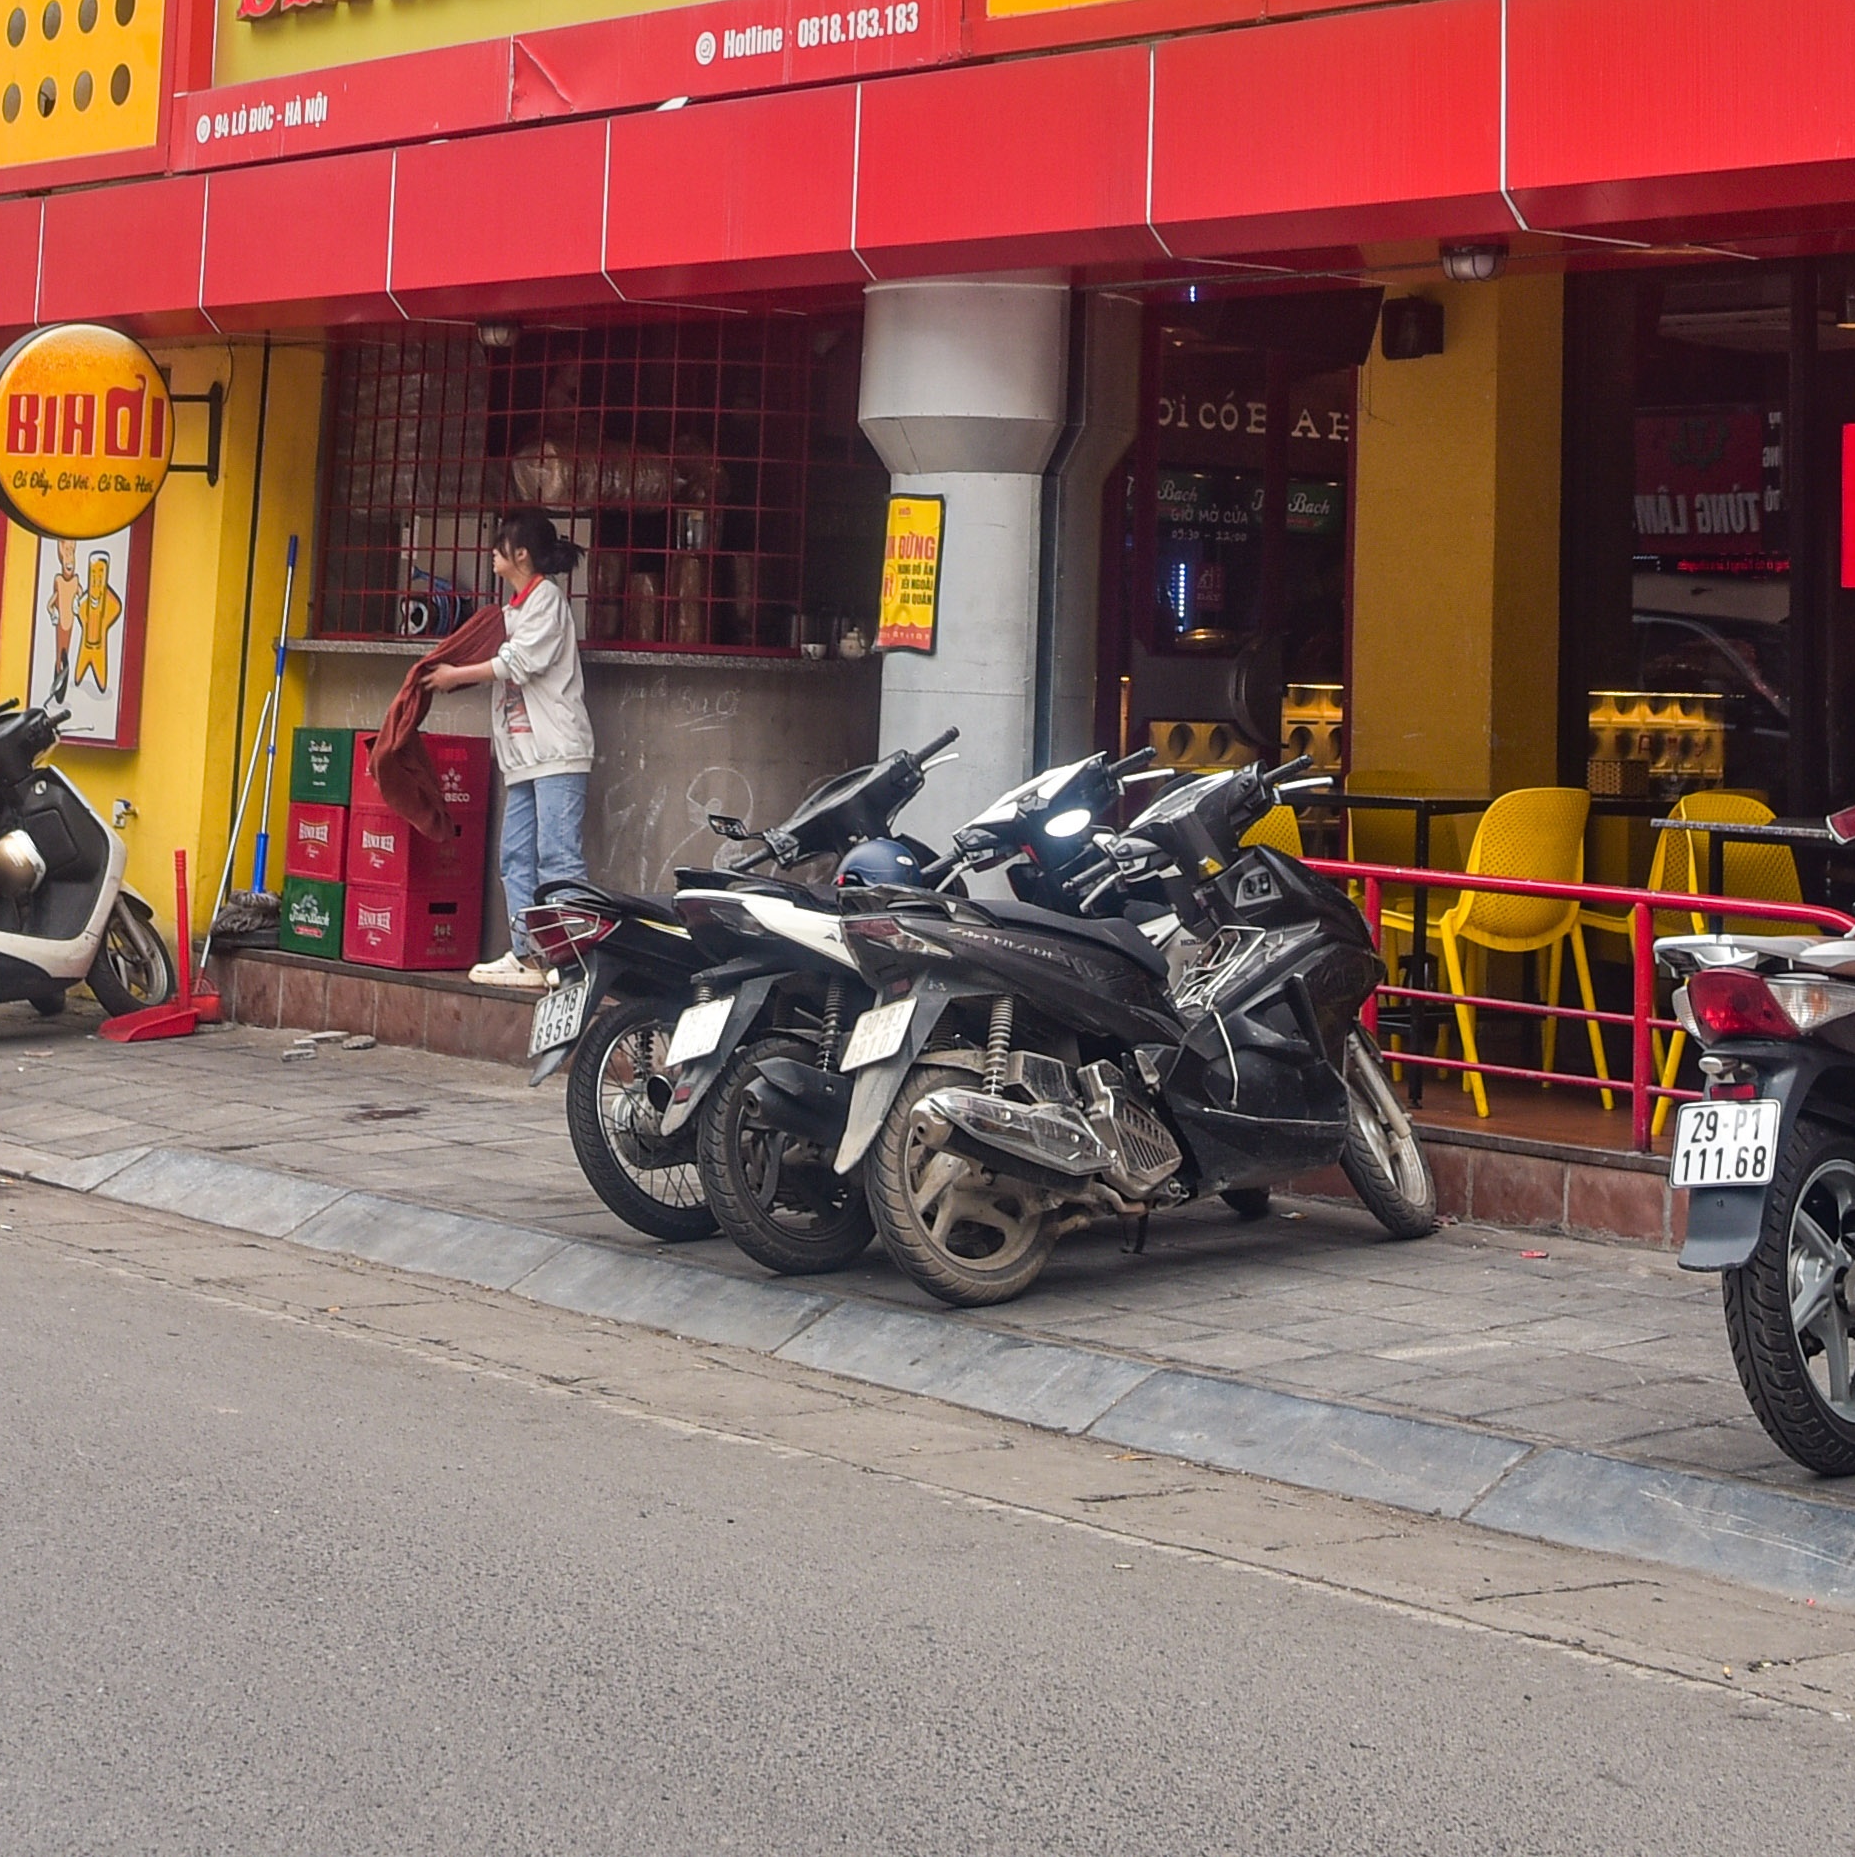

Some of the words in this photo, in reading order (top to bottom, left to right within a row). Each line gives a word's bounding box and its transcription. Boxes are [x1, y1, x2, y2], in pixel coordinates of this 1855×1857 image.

[723, 25, 783, 59] Hotline
[797, 1, 919, 48] 0818.183.183
[214, 113, 228, 139] 94
[231, 104, 246, 136] LÒ
[249, 101, 274, 133] ĐÚC
[284, 95, 301, 127] HÀ
[304, 91, 328, 128] NỘI
[899, 531, 935, 560] ĐỪNG
[445, 792, 471, 803] BECO
[536, 1015, 573, 1049] 6956
[1691, 1108, 1761, 1143] 29-P1
[1683, 1146, 1767, 1181] 111.68
